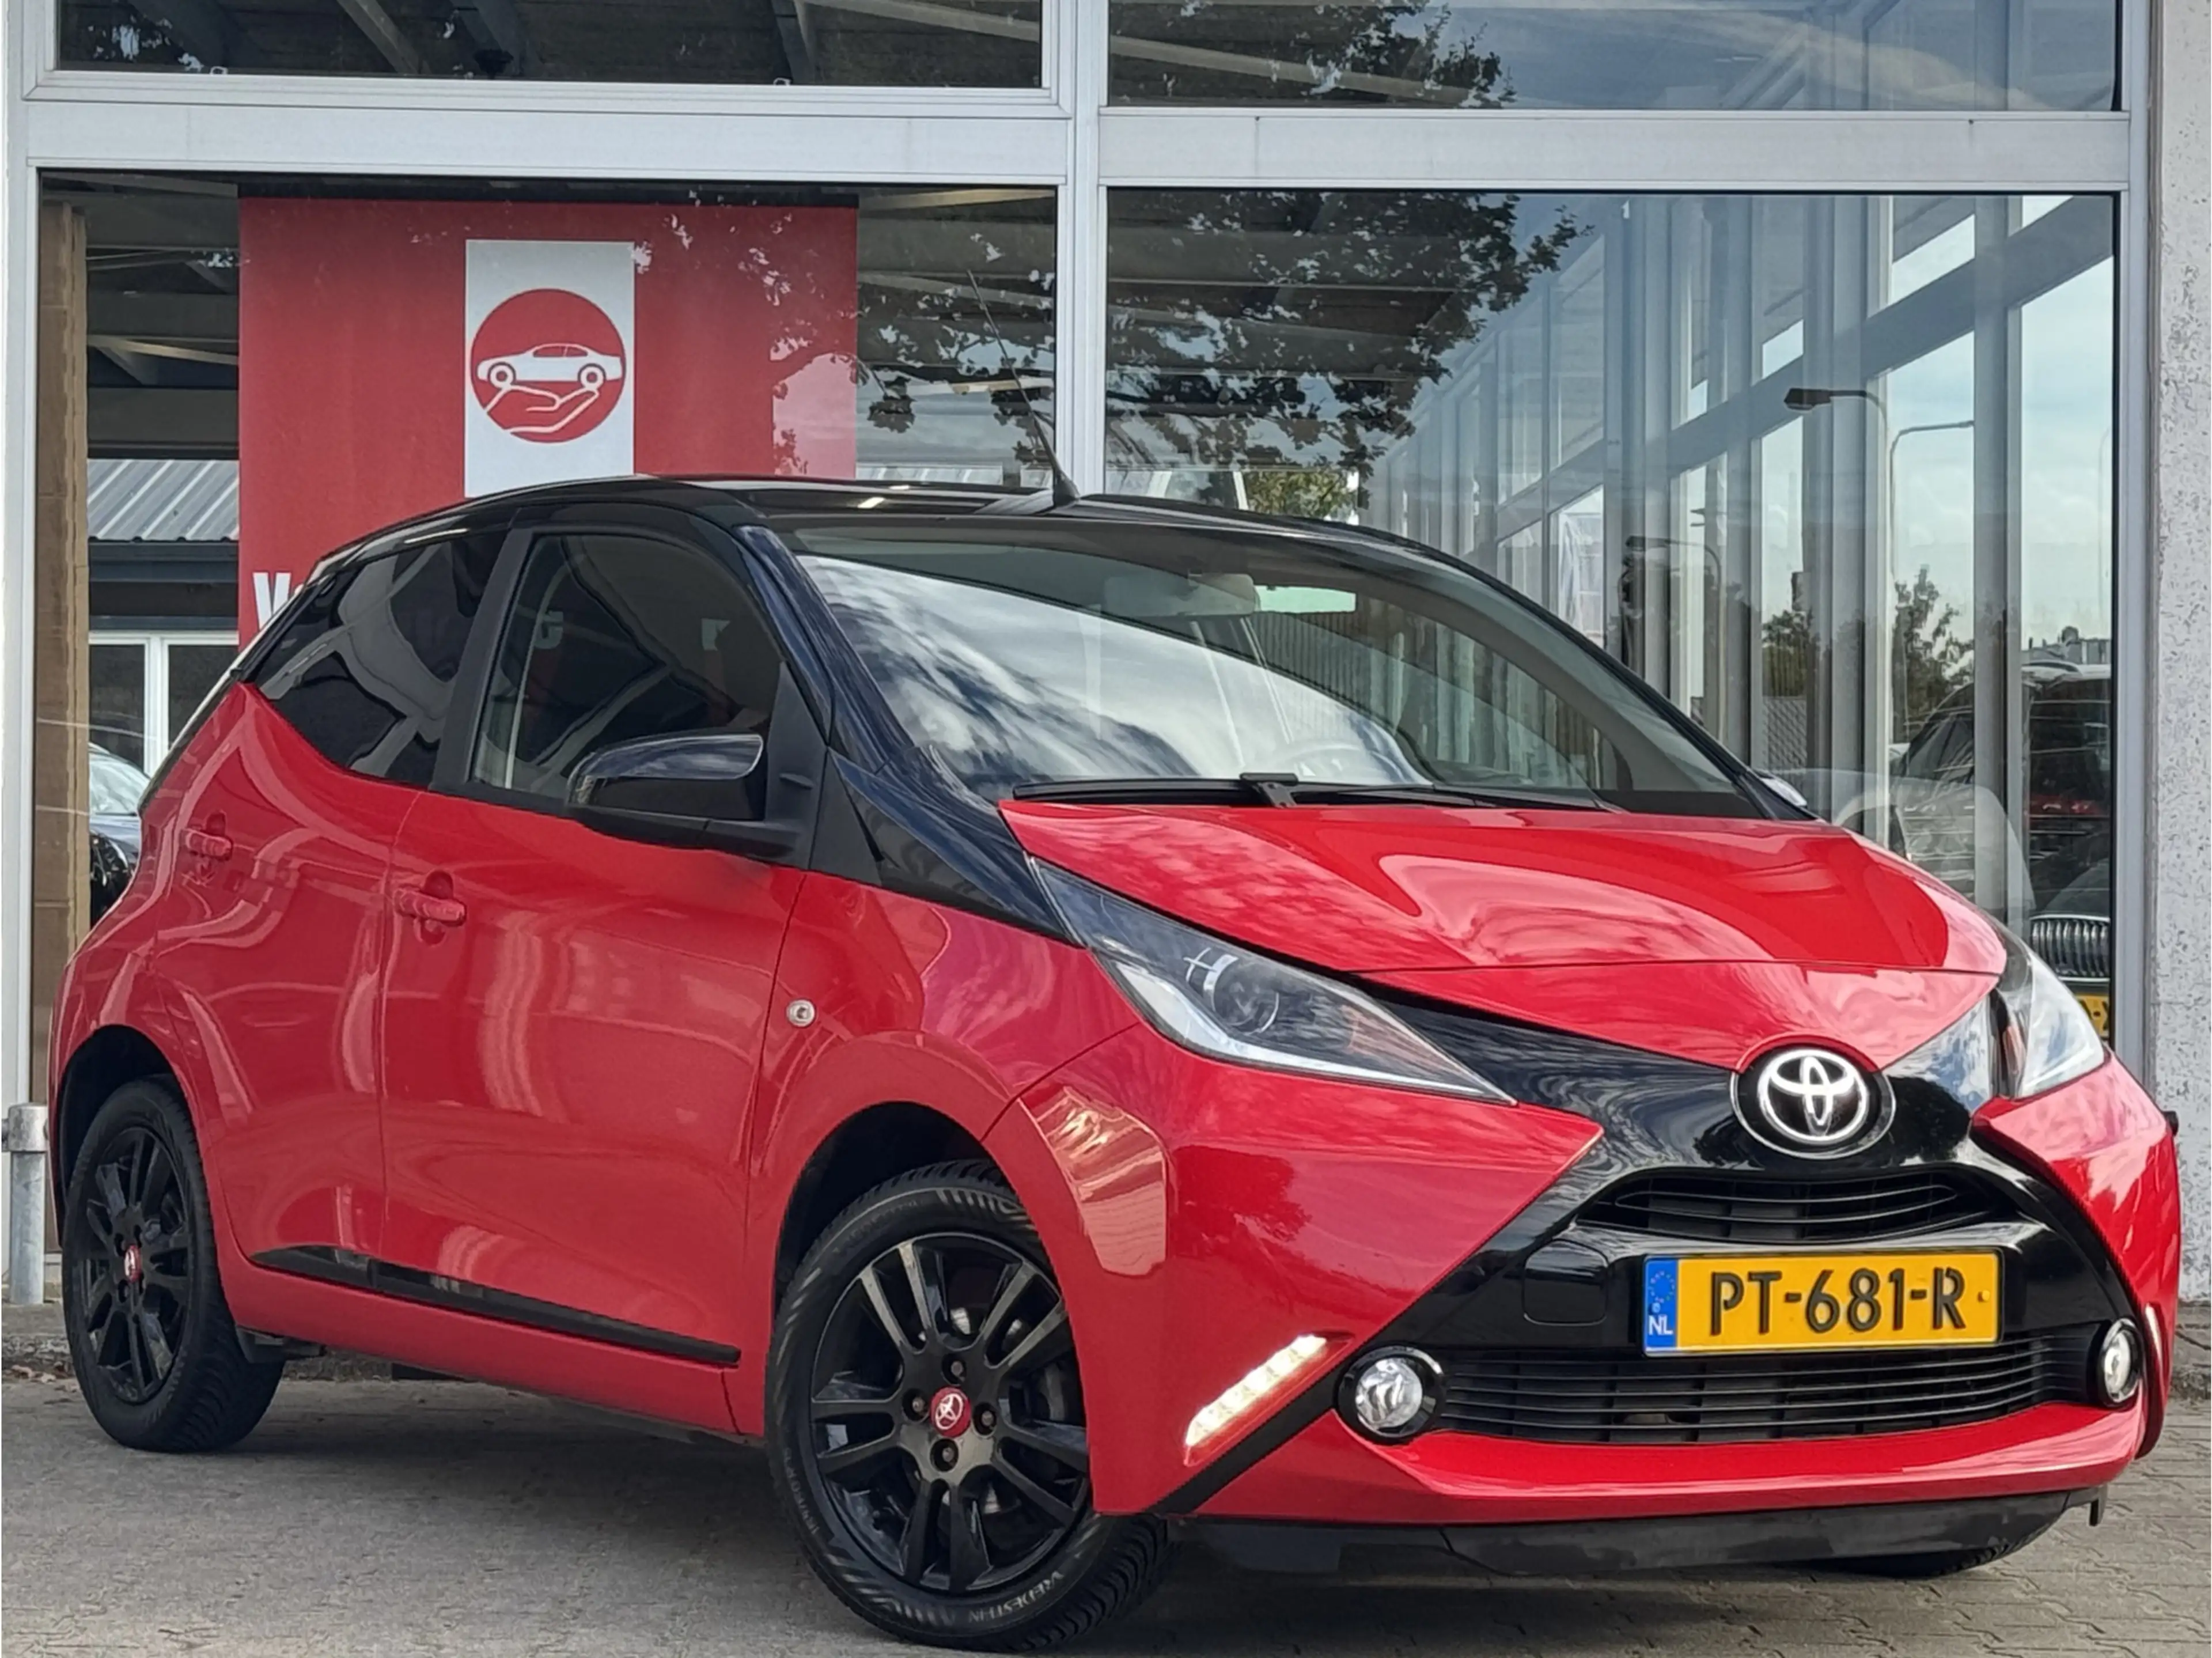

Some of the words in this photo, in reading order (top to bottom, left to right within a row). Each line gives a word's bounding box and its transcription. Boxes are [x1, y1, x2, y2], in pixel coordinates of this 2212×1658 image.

[252, 571, 304, 631] V
[1647, 1314, 1674, 1336] NL
[1709, 1267, 1966, 1336] PT-681-R
